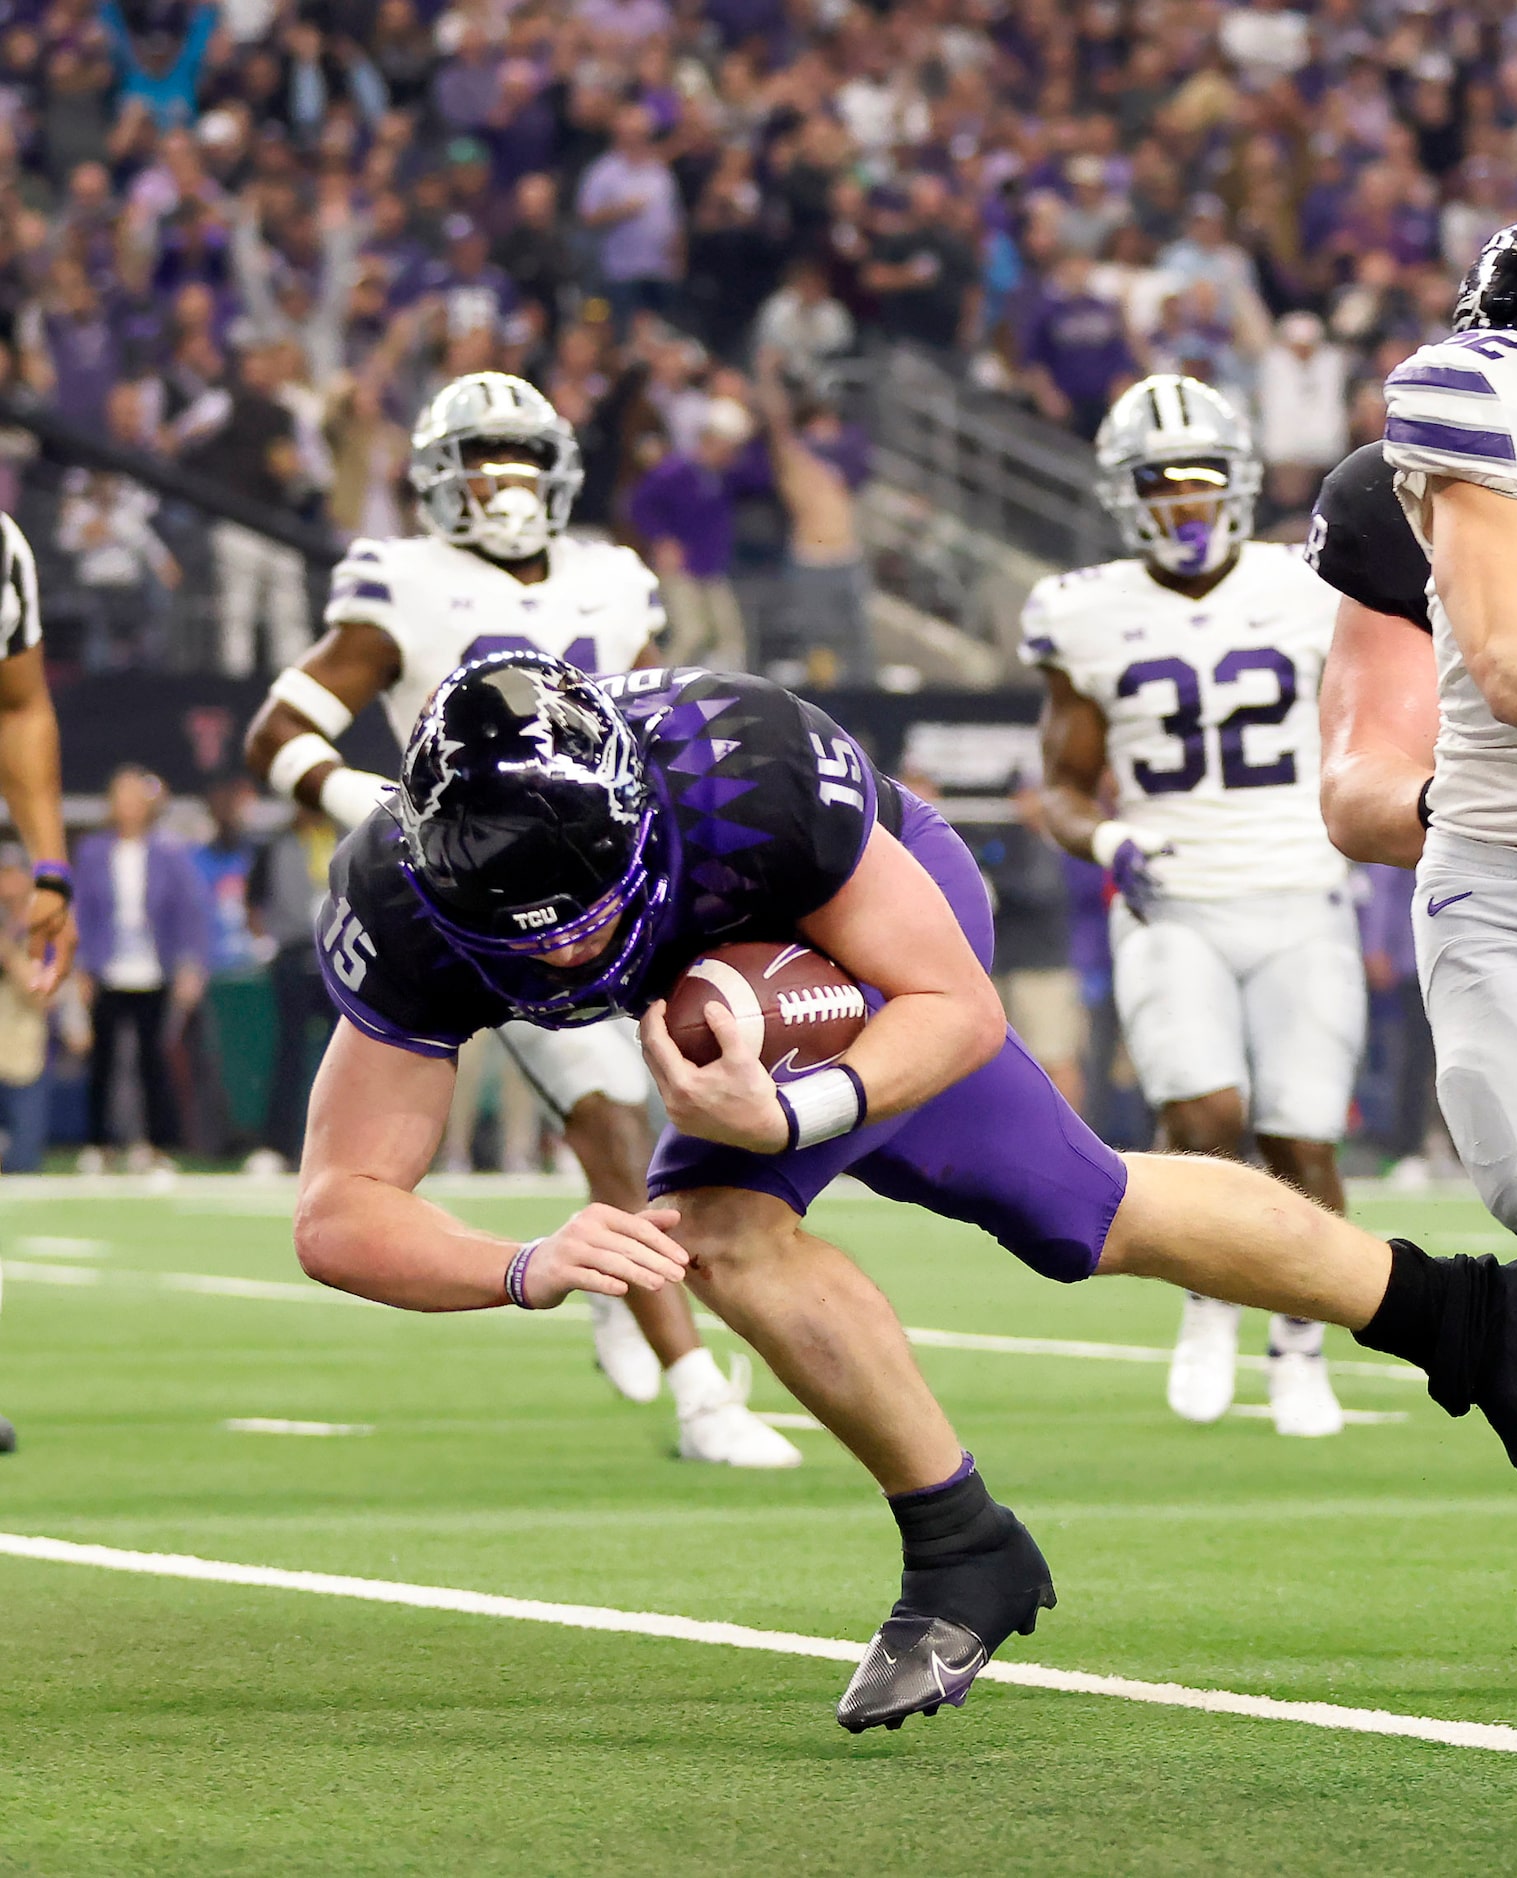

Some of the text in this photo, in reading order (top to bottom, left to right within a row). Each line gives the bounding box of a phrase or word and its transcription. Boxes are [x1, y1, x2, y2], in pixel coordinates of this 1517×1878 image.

[1116, 646, 1298, 795] 32
[808, 730, 866, 814] 15
[322, 895, 378, 993] 15
[512, 905, 559, 931] TCU
